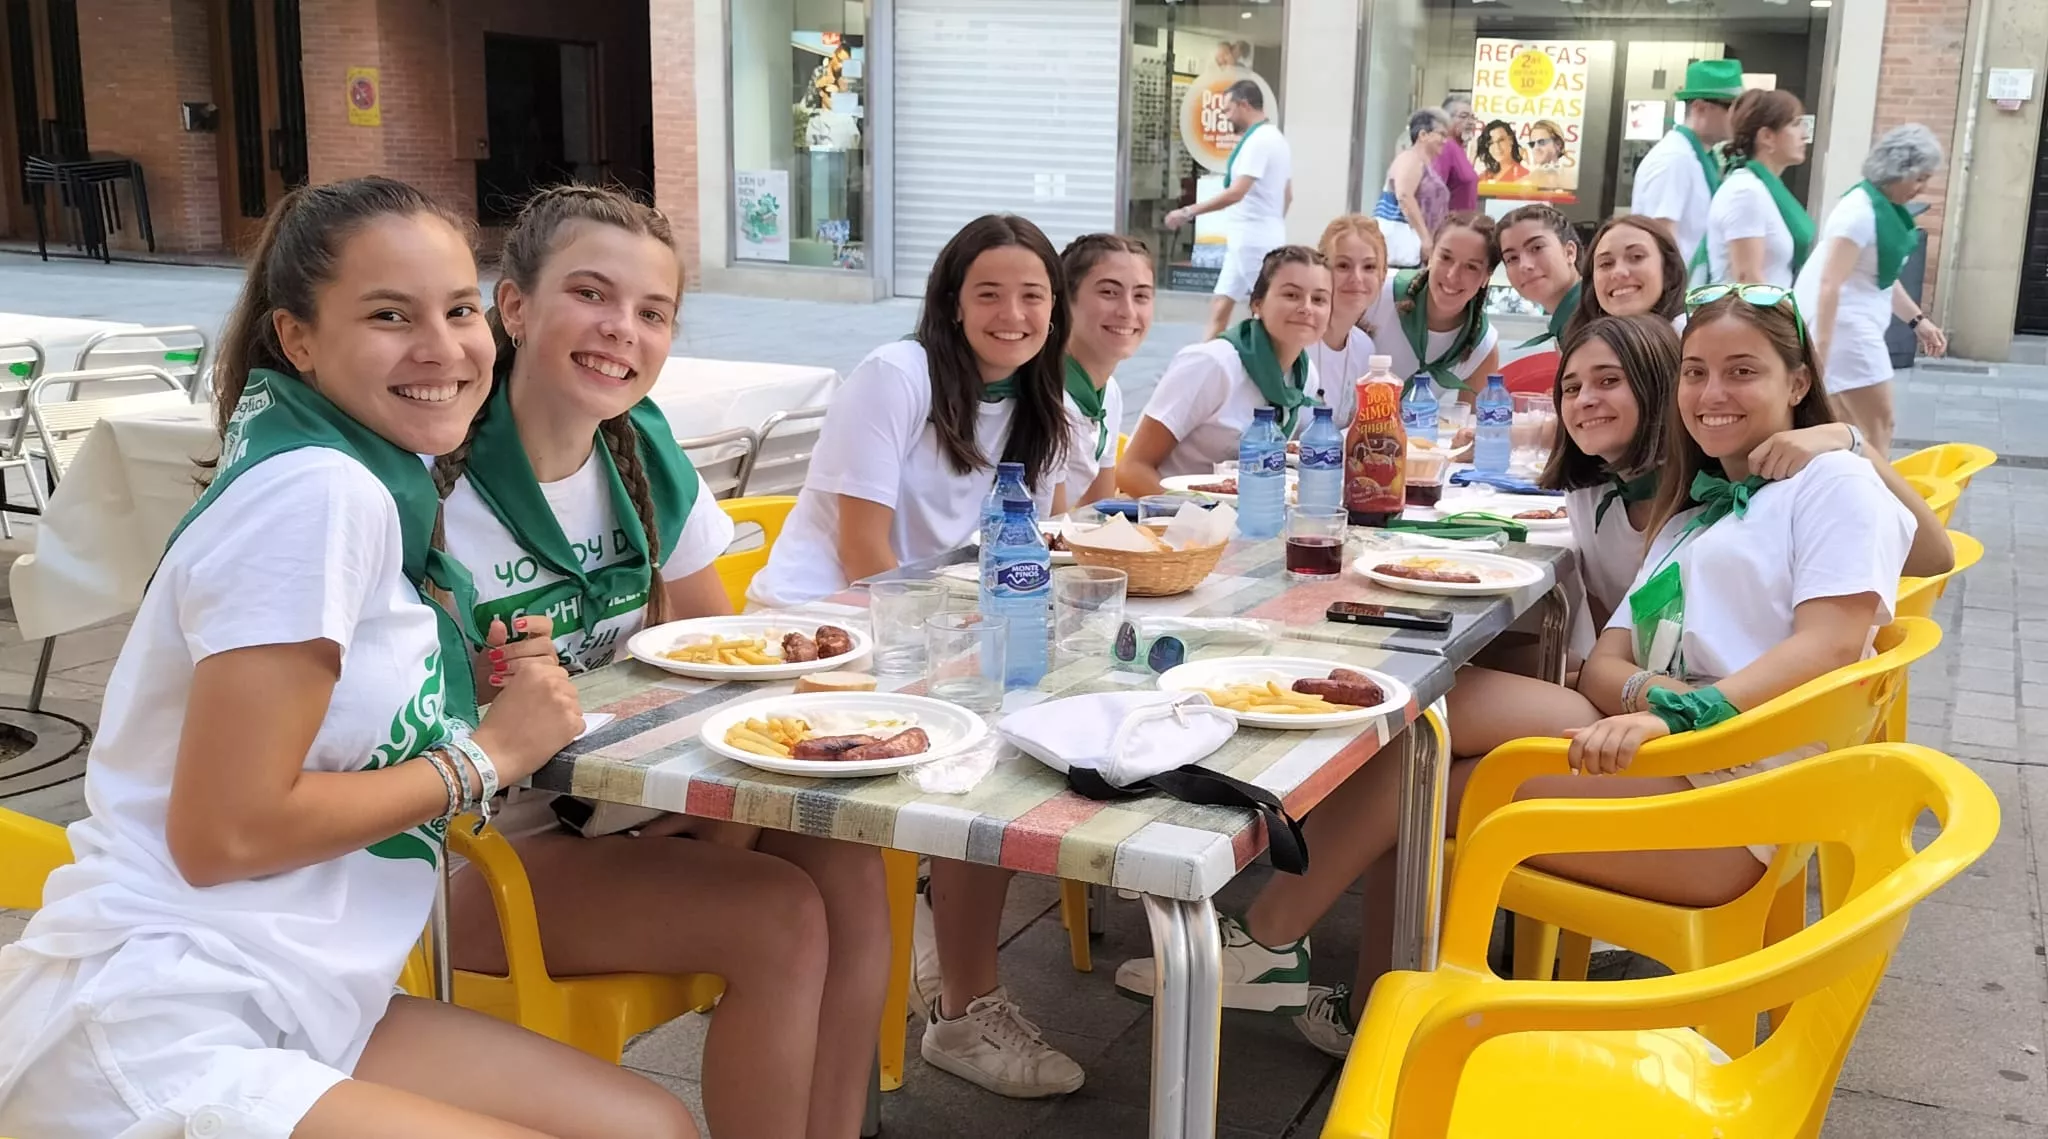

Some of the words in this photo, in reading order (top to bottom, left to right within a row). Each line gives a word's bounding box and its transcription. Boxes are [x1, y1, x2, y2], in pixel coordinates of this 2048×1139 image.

[1476, 69, 1585, 91] REAS
[1474, 94, 1582, 117] REGAFAS
[495, 555, 538, 588] YO
[571, 534, 603, 565] OY
[1011, 564, 1039, 572] MONTE
